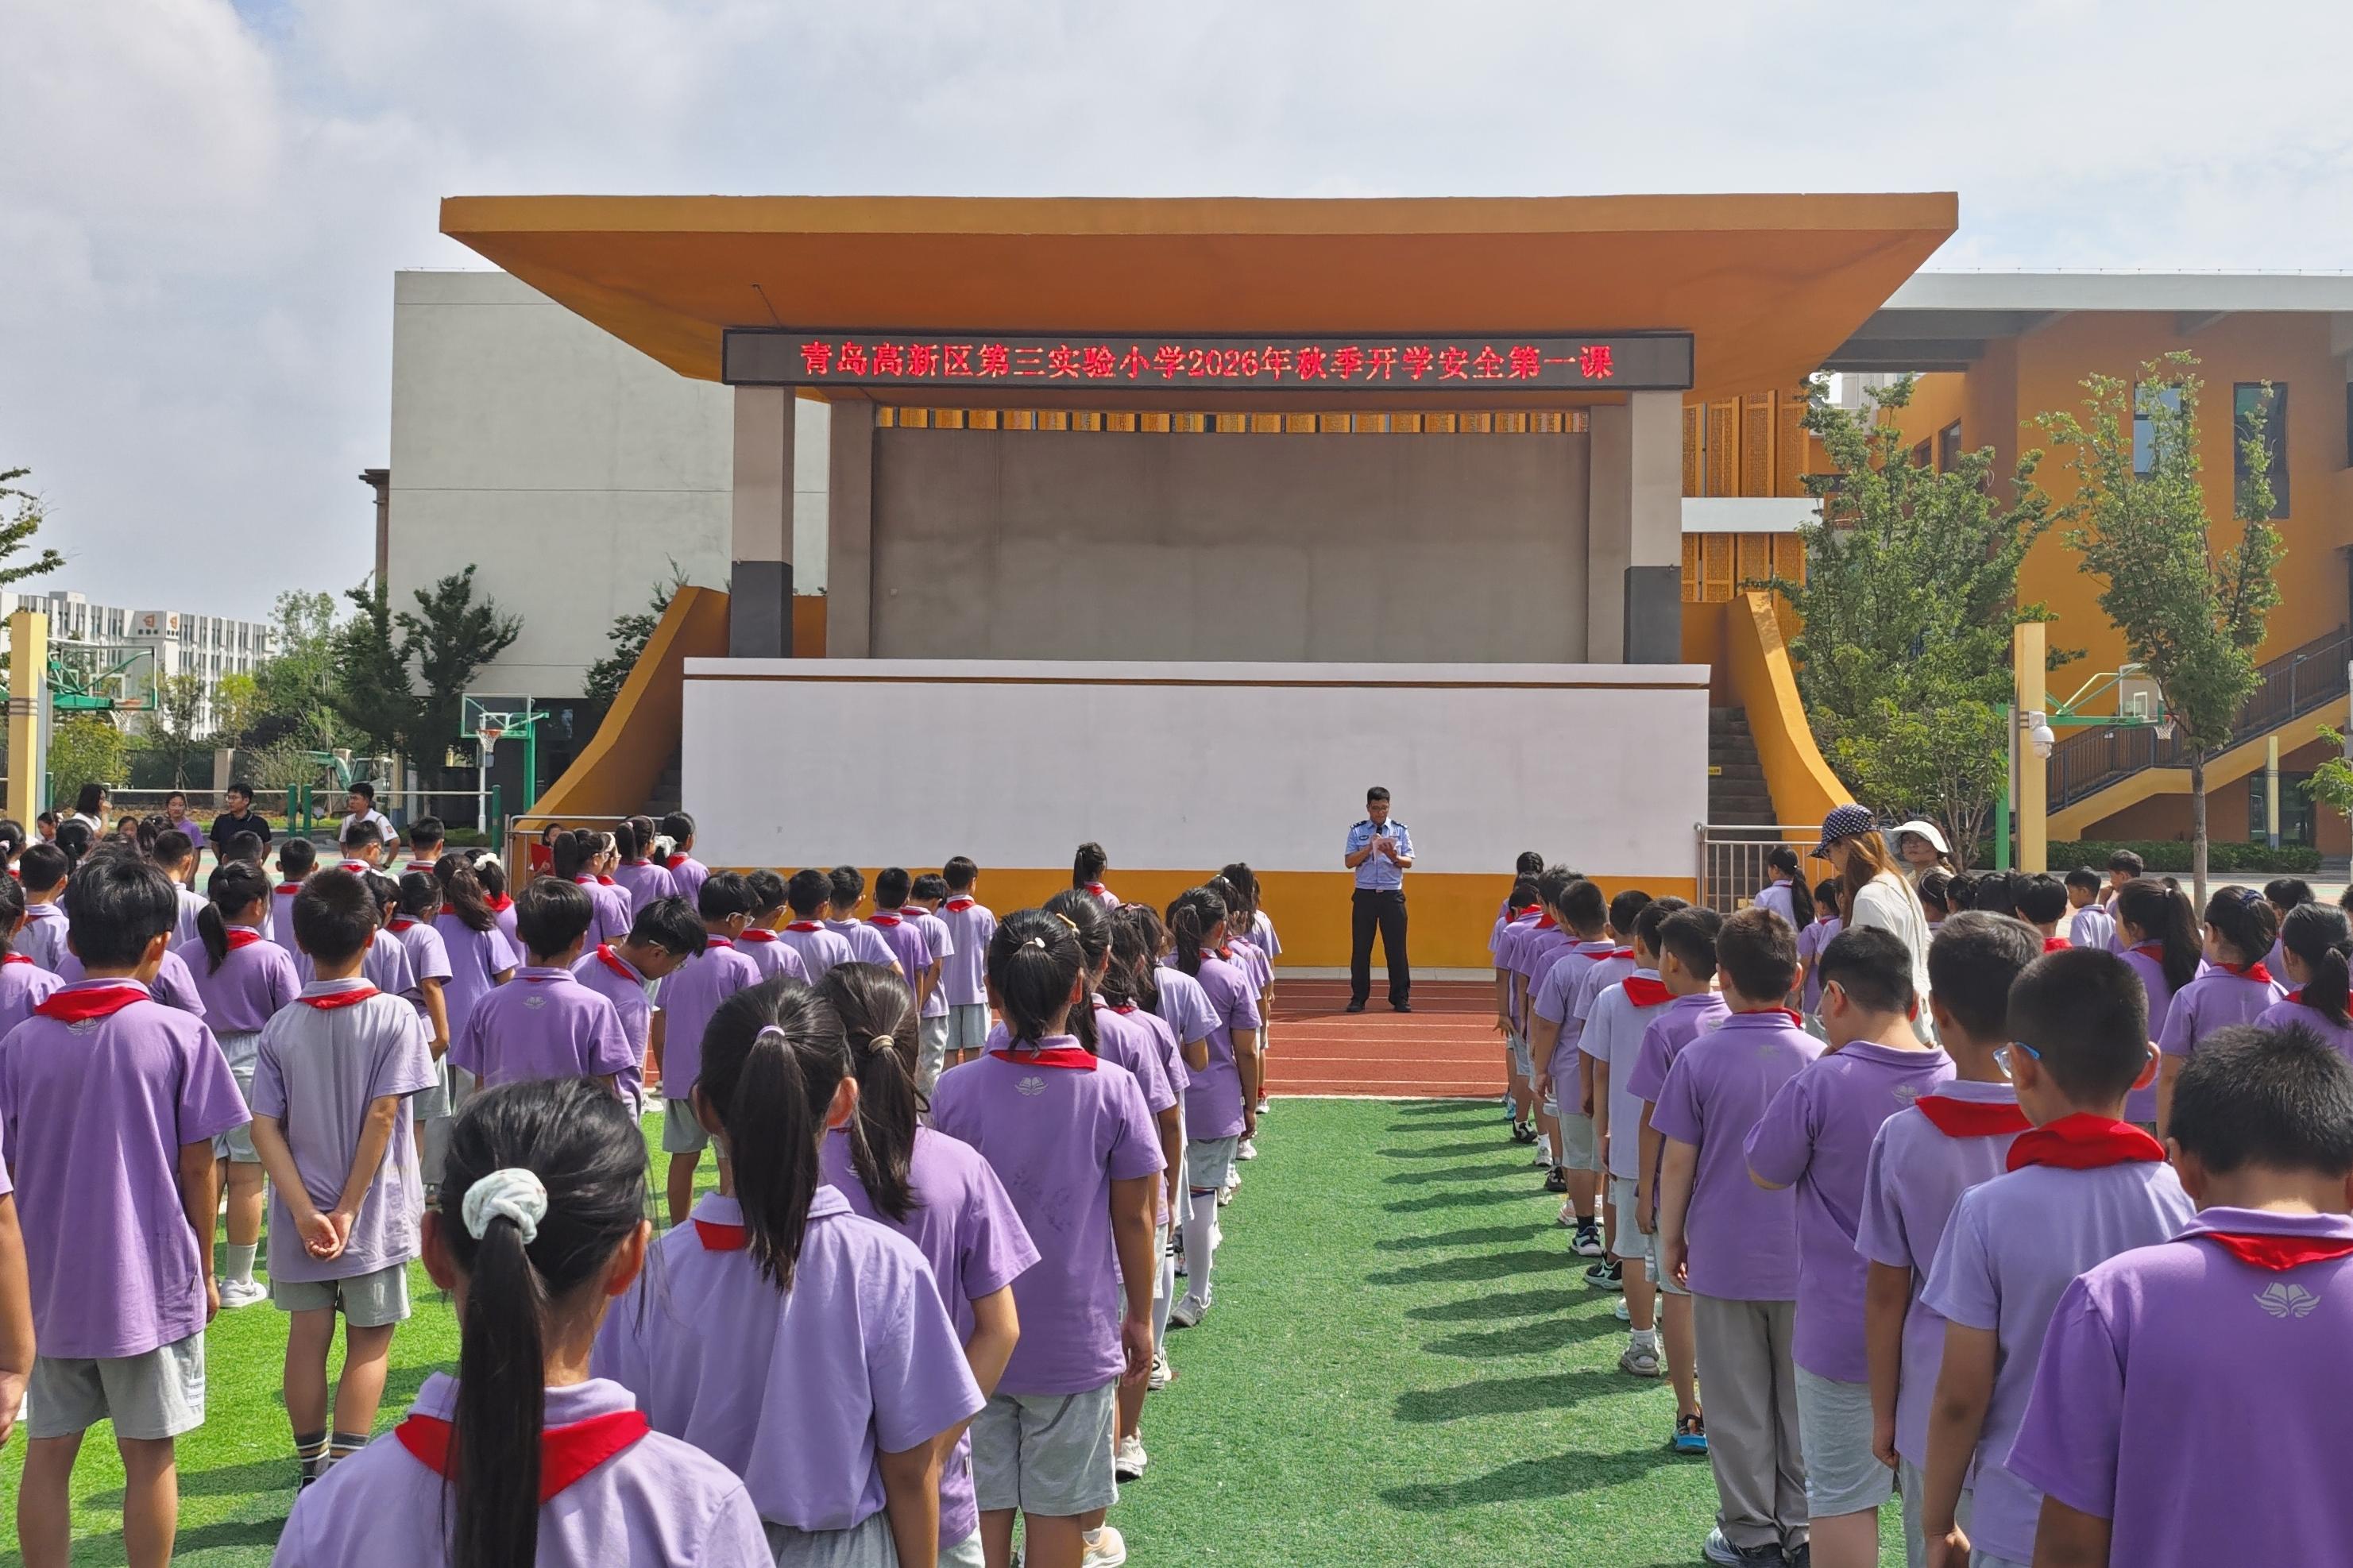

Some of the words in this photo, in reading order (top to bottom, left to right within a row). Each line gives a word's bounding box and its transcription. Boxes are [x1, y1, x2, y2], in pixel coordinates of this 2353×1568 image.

[800, 341, 1614, 380] 青岛高新区第三实验小学2026年秋季开学安全第一课
